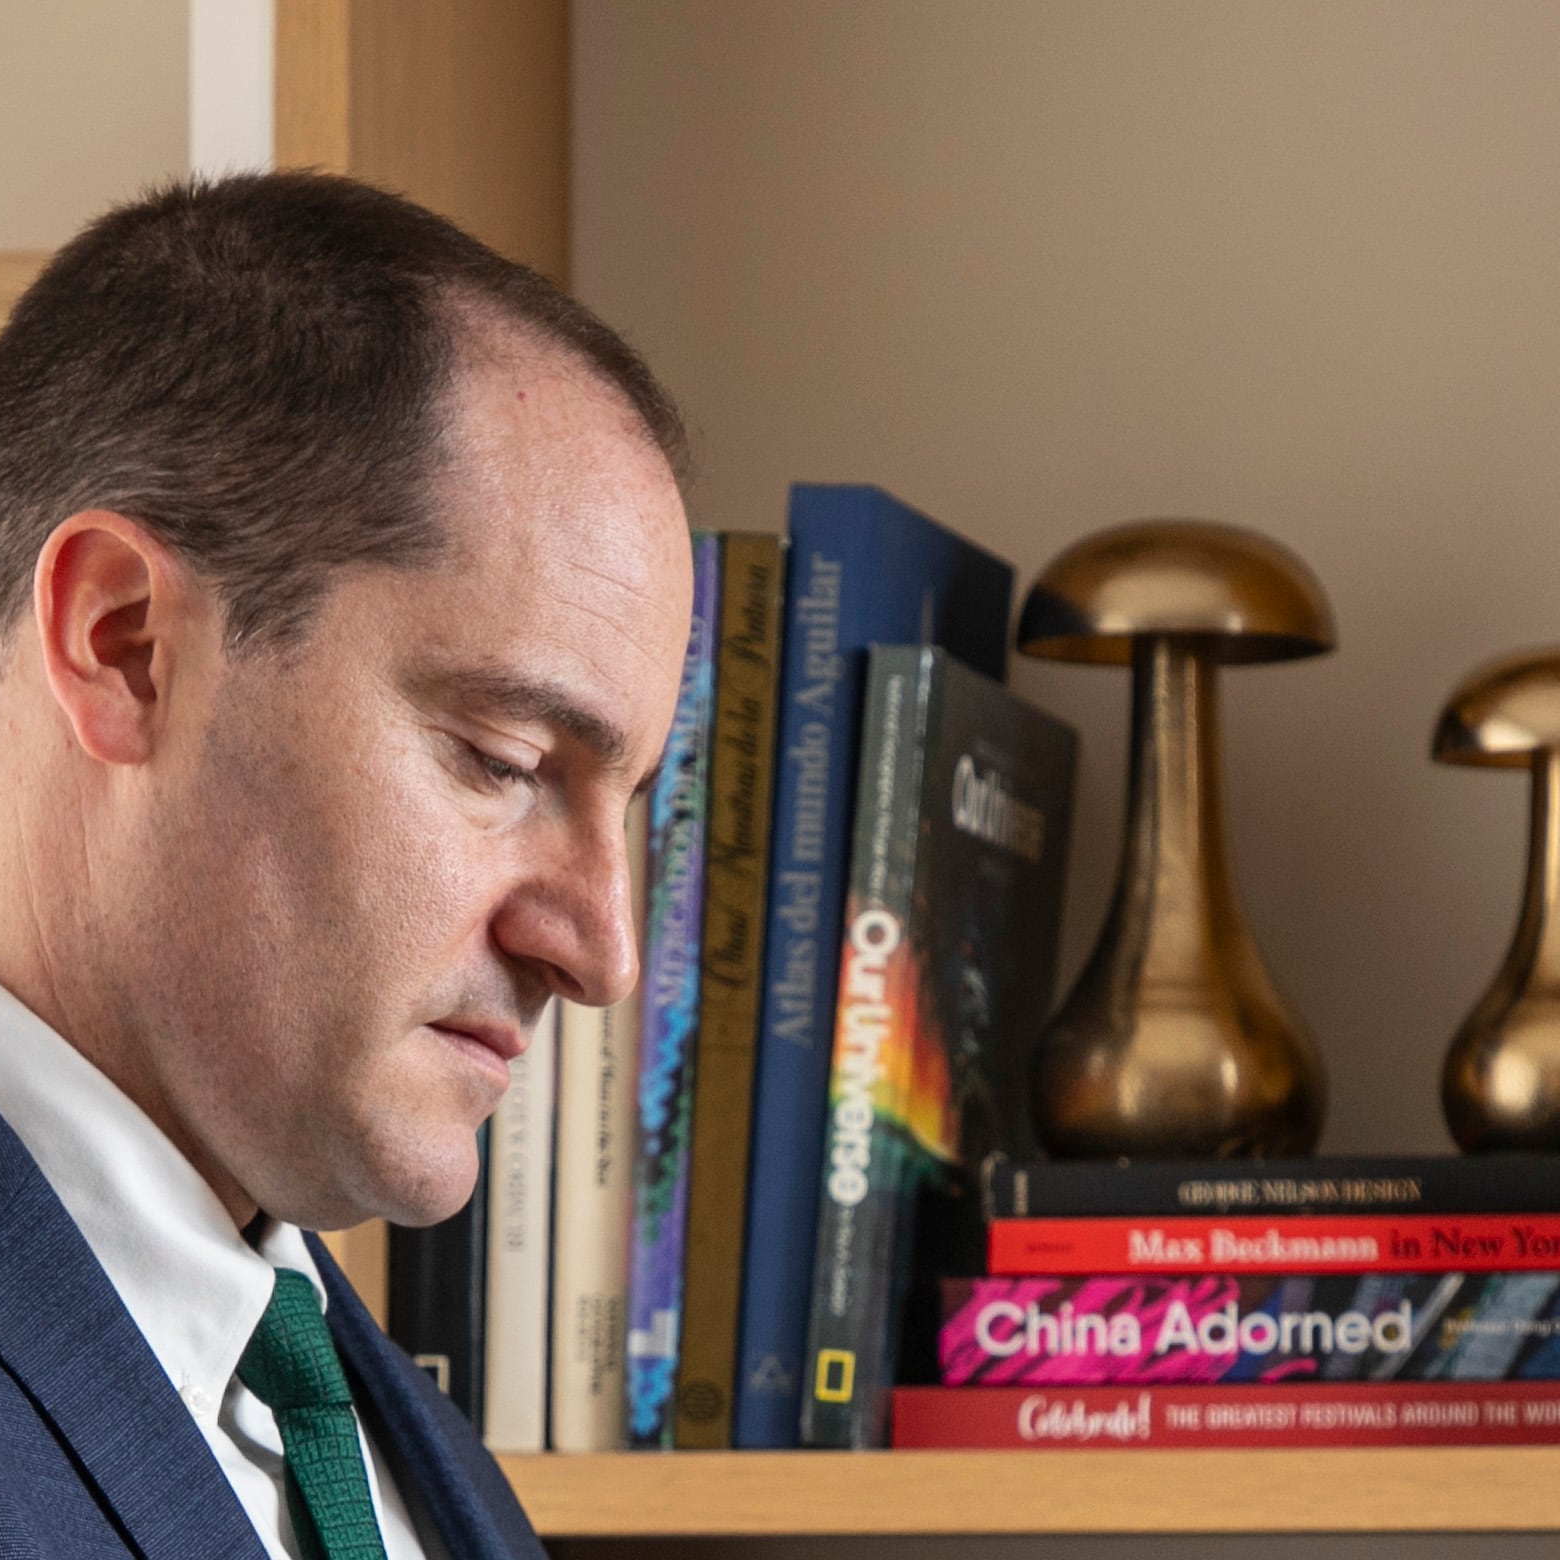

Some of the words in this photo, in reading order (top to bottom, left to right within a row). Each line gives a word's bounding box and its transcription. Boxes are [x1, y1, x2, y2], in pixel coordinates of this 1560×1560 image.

[795, 553, 845, 714] Aguilar
[787, 721, 831, 861] mundo
[779, 870, 823, 934] del
[768, 938, 817, 1048] Atlas
[850, 910, 901, 1001] Our
[828, 1003, 892, 1206] Universe
[1177, 1180, 1257, 1206] GEORGE
[1261, 1178, 1339, 1205] NELSON
[1342, 1177, 1422, 1202] DESIGN
[1128, 1230, 1204, 1264] Max
[1209, 1228, 1379, 1264] Beckmann
[1390, 1228, 1420, 1258] in
[1432, 1225, 1504, 1258] New
[974, 1300, 1140, 1357] China
[1154, 1299, 1412, 1356] Adorned
[1017, 1392, 1152, 1442] Celebrate!
[1166, 1404, 1201, 1430] THE
[1205, 1404, 1297, 1430] GREATEST
[1302, 1403, 1397, 1430] FESTIVALS
[1402, 1402, 1479, 1428] AROUND
[1486, 1401, 1517, 1426] THE
